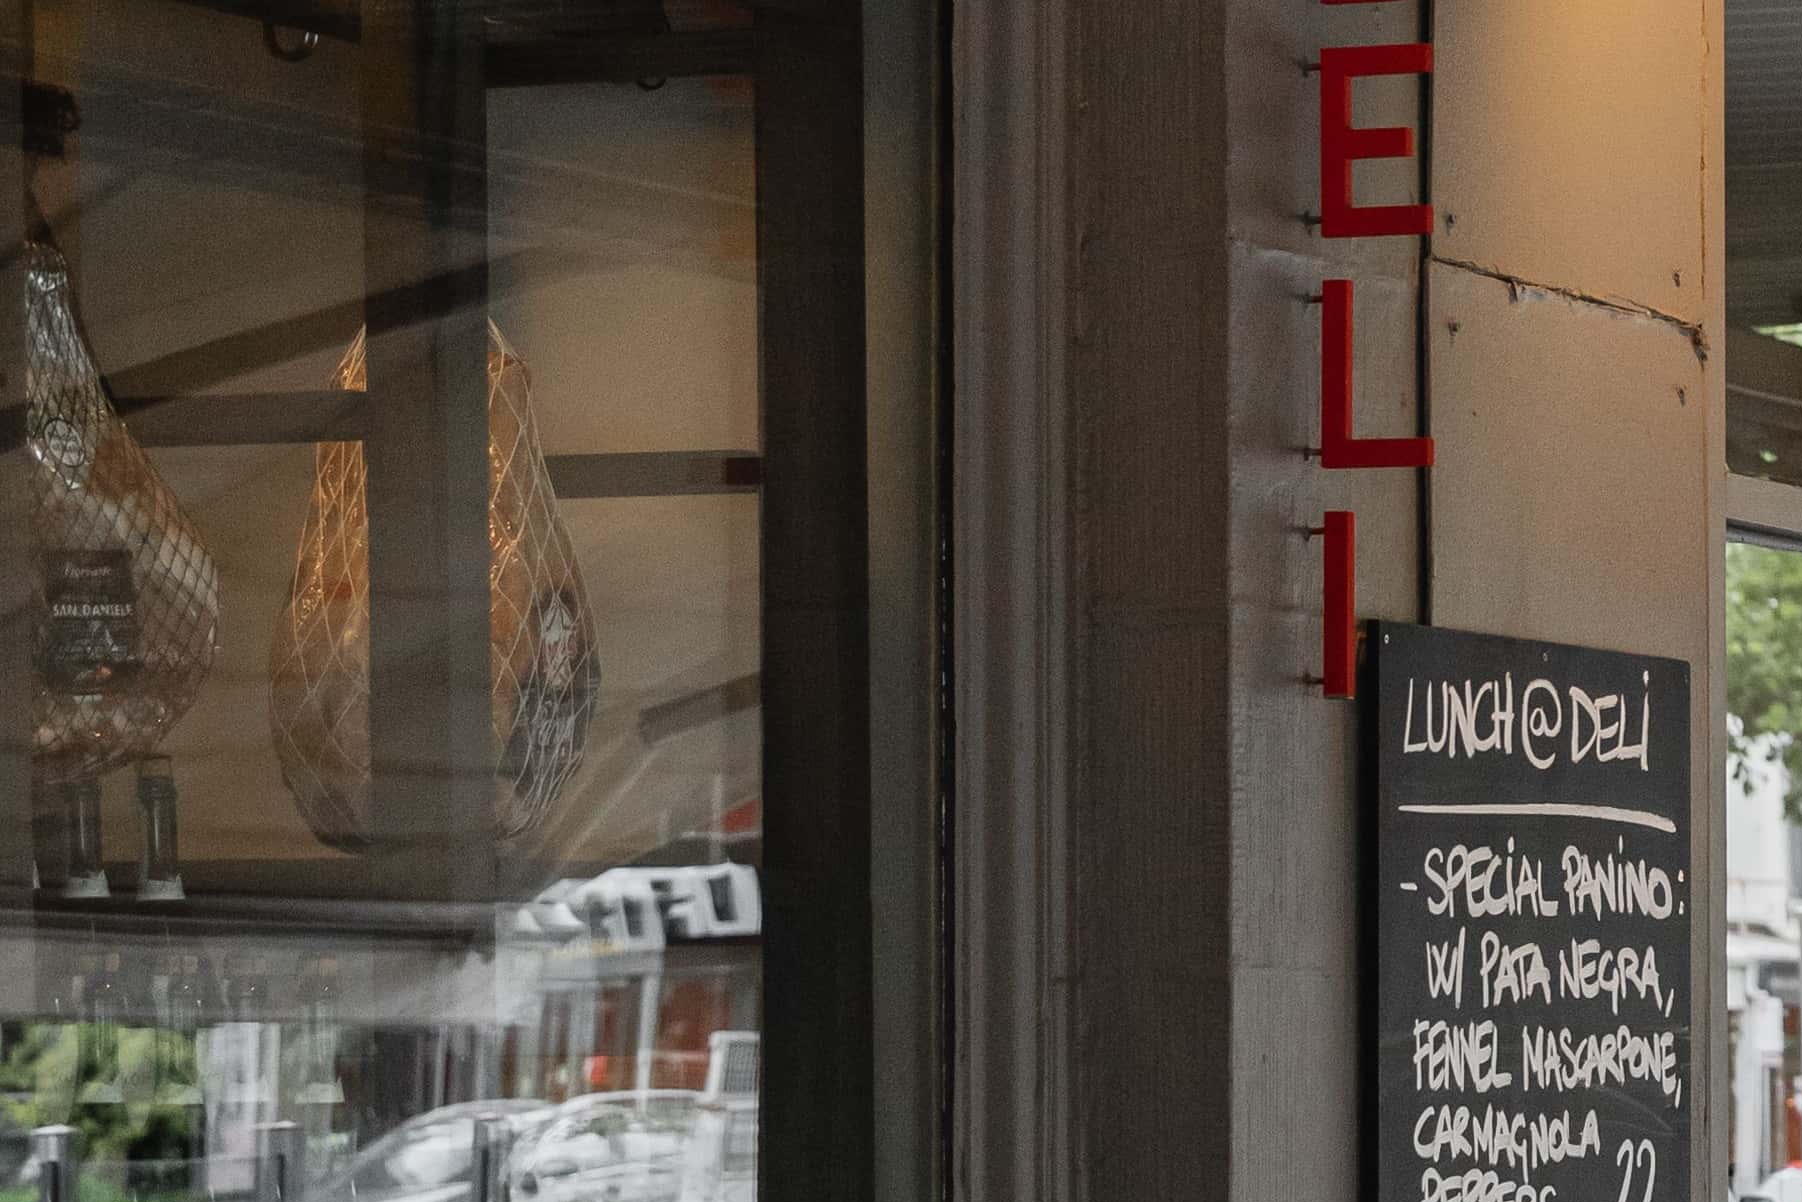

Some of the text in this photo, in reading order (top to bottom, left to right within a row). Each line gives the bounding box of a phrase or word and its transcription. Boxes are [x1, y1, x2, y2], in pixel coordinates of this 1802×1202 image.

[1320, 0, 1434, 699] ELI
[1403, 671, 1514, 759] LUNCH
[1480, 930, 1551, 1009] PATA
[1412, 1017, 1512, 1093] FENNEL
[1413, 1103, 1600, 1184] CARMAGNOLA
